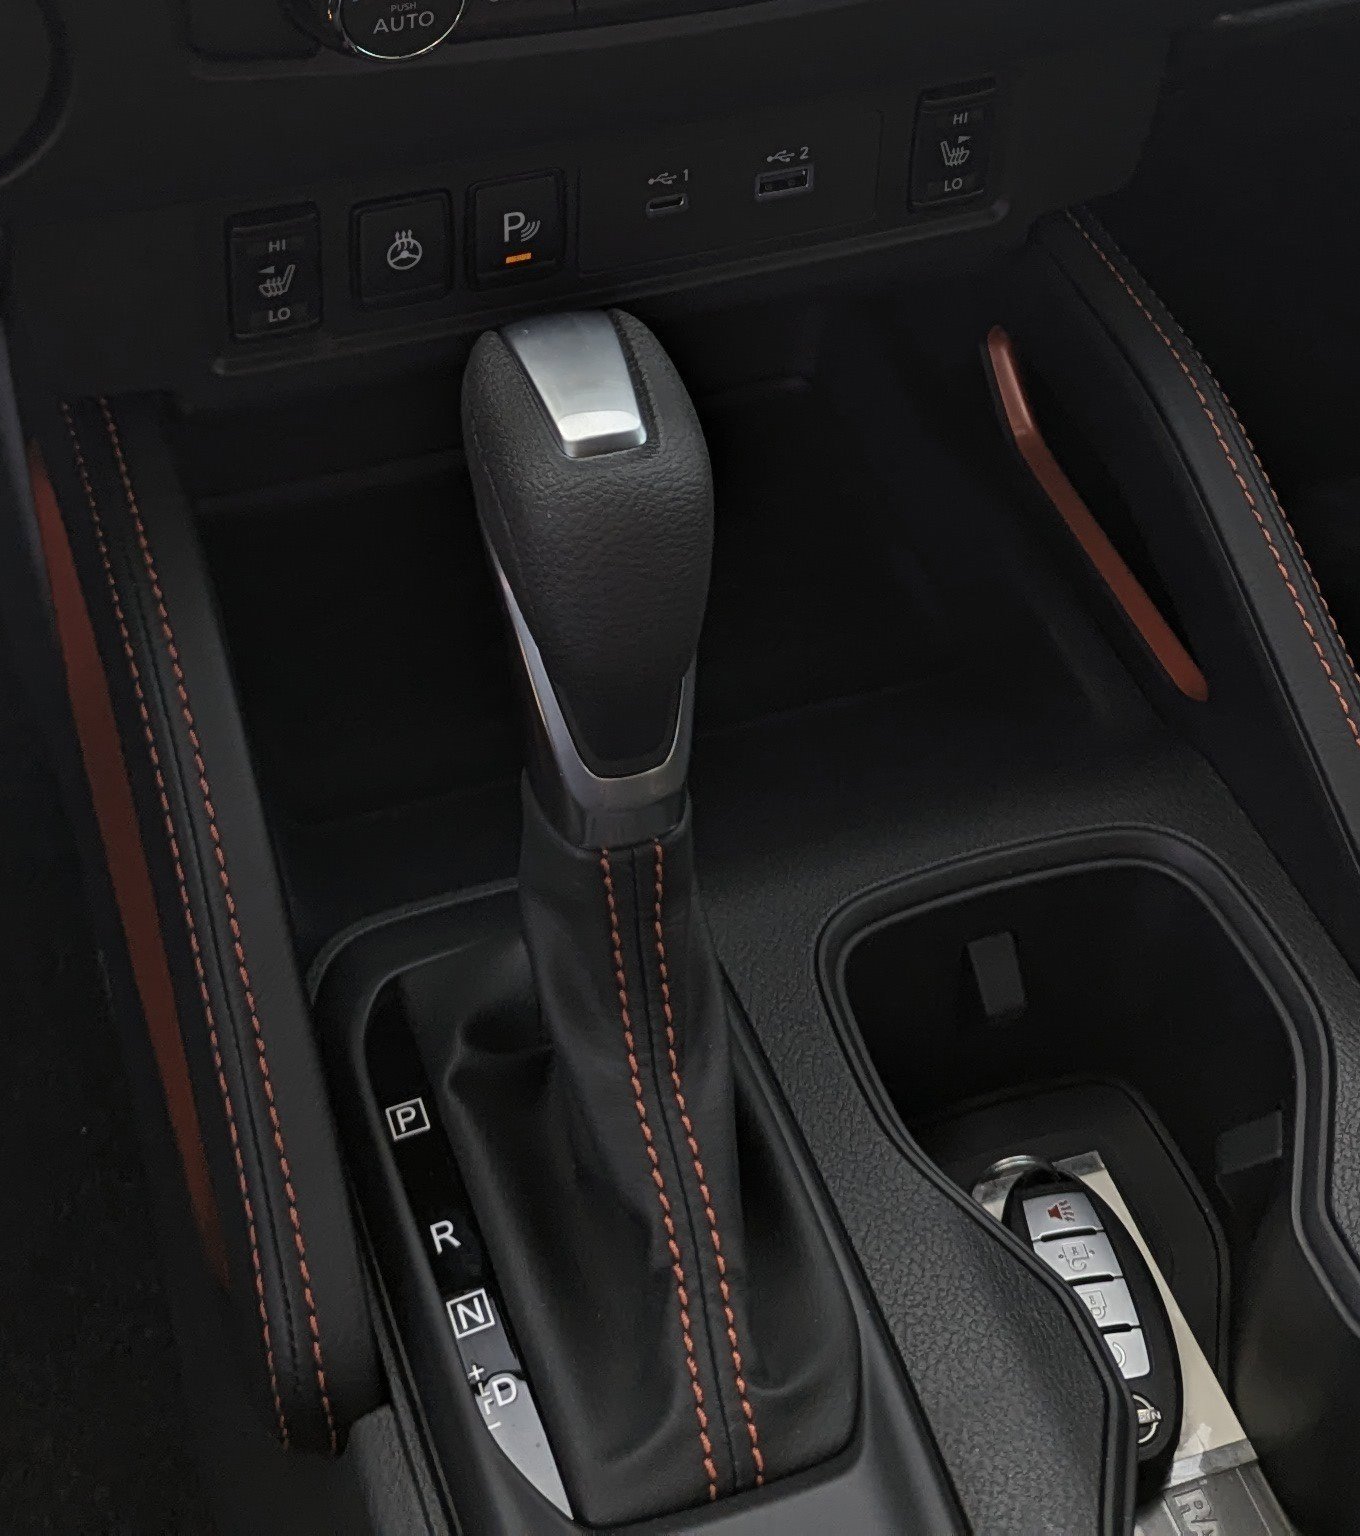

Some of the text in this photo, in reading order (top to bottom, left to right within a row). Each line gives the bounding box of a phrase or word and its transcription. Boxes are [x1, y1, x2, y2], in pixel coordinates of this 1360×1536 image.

[390, 1, 418, 14] PUSH
[372, 9, 436, 36] AUTO
[952, 112, 969, 126] HI
[799, 146, 810, 161] 2
[683, 168, 690, 182] 1
[944, 177, 963, 192] LO
[503, 211, 525, 244] P
[268, 239, 286, 253] HI
[268, 307, 291, 324] LO
[396, 1105, 417, 1134] P
[430, 1220, 462, 1254] R
[456, 1298, 485, 1330] N
[492, 1377, 517, 1406] D
